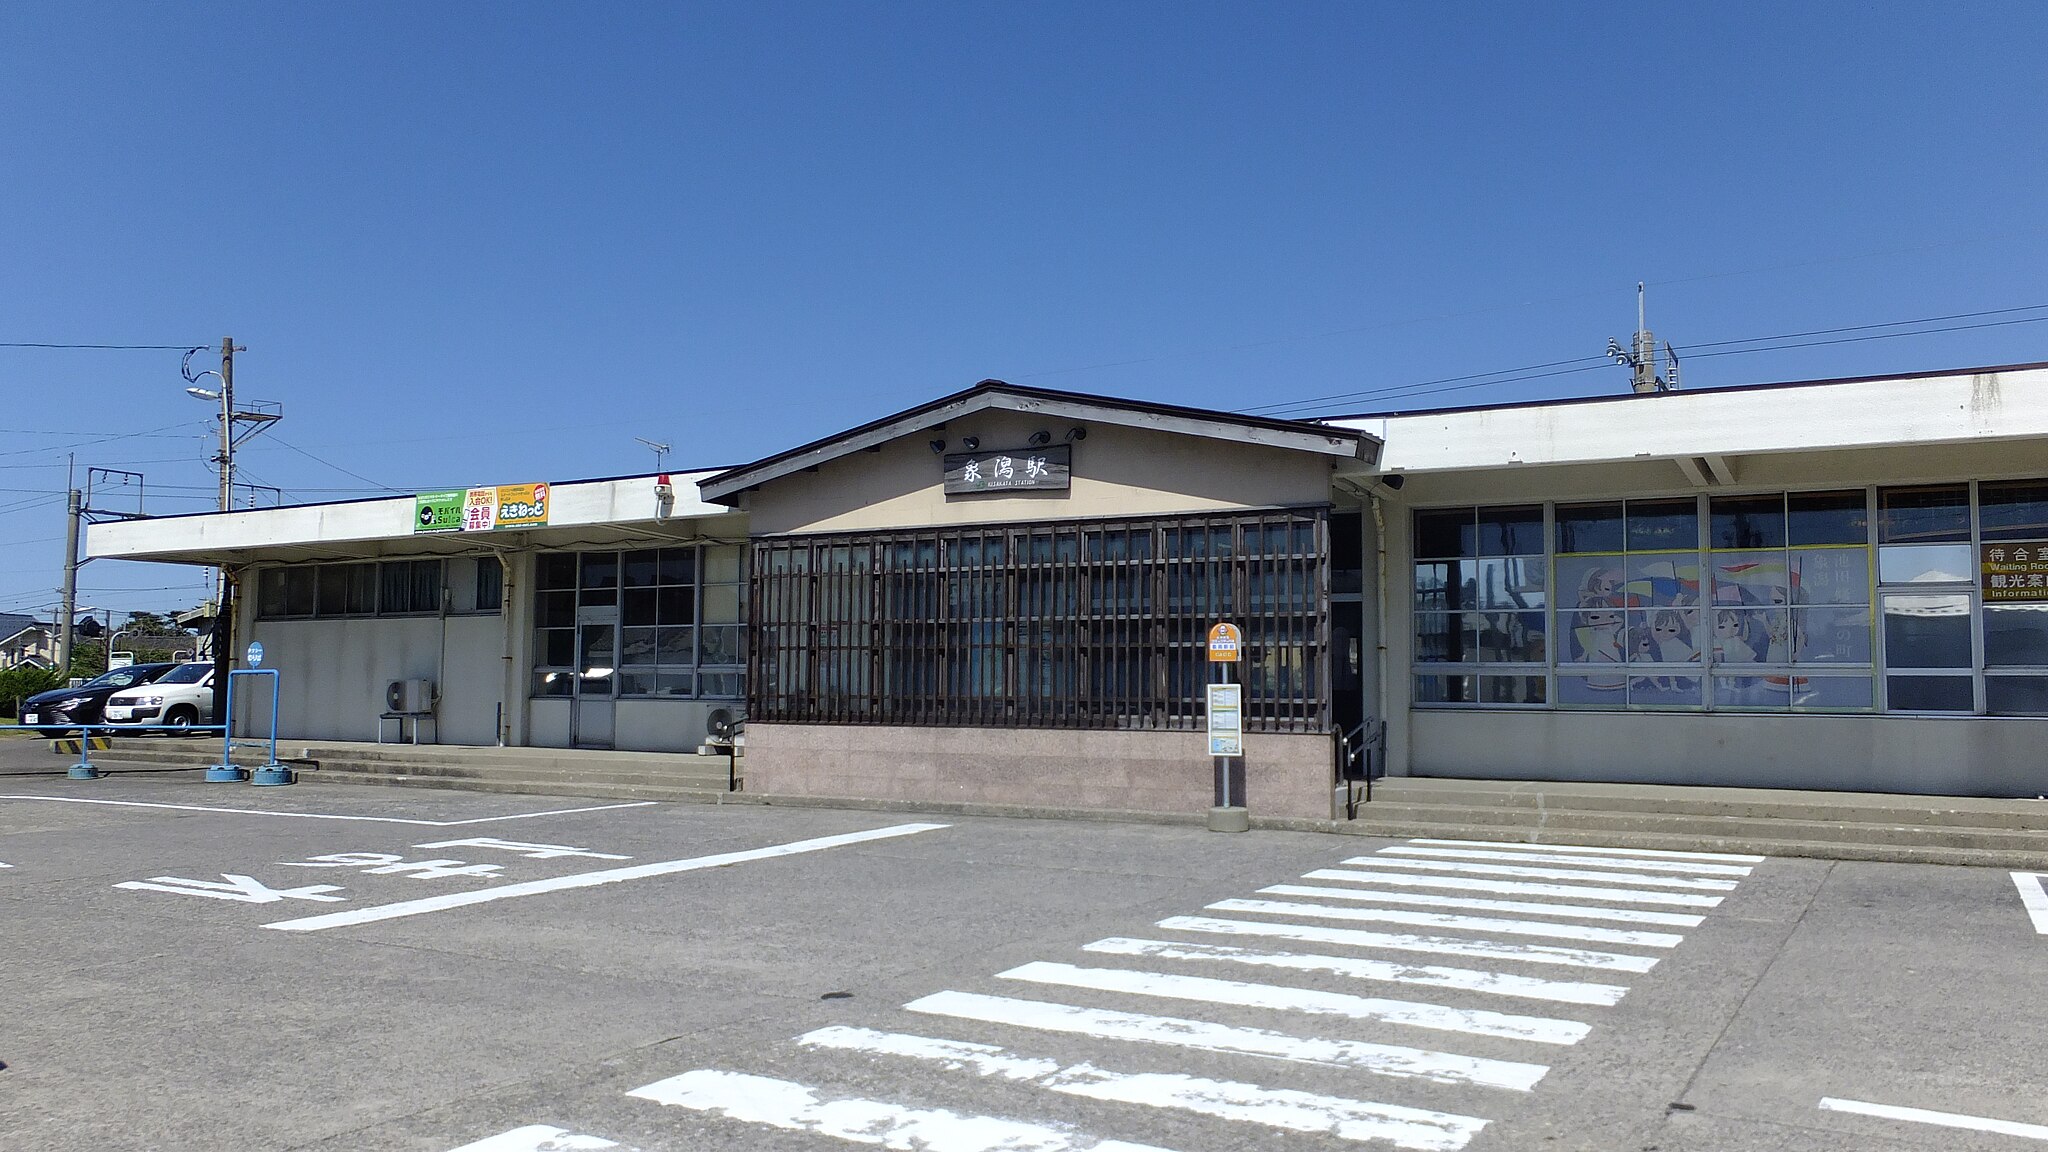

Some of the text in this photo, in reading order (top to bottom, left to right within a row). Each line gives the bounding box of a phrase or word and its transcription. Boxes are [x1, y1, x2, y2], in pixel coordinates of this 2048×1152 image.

[964, 455, 1048, 482] 象潟駅
[438, 506, 462, 515] モバイル
[470, 506, 490, 520] 会員
[500, 502, 544, 518] えきねっと
[437, 516, 461, 524] Suica
[1989, 546, 2048, 562] 待合室
[1990, 562, 2027, 571] Waiting
[1990, 573, 2048, 588] 観光案
[1992, 589, 2048, 597] Informati
